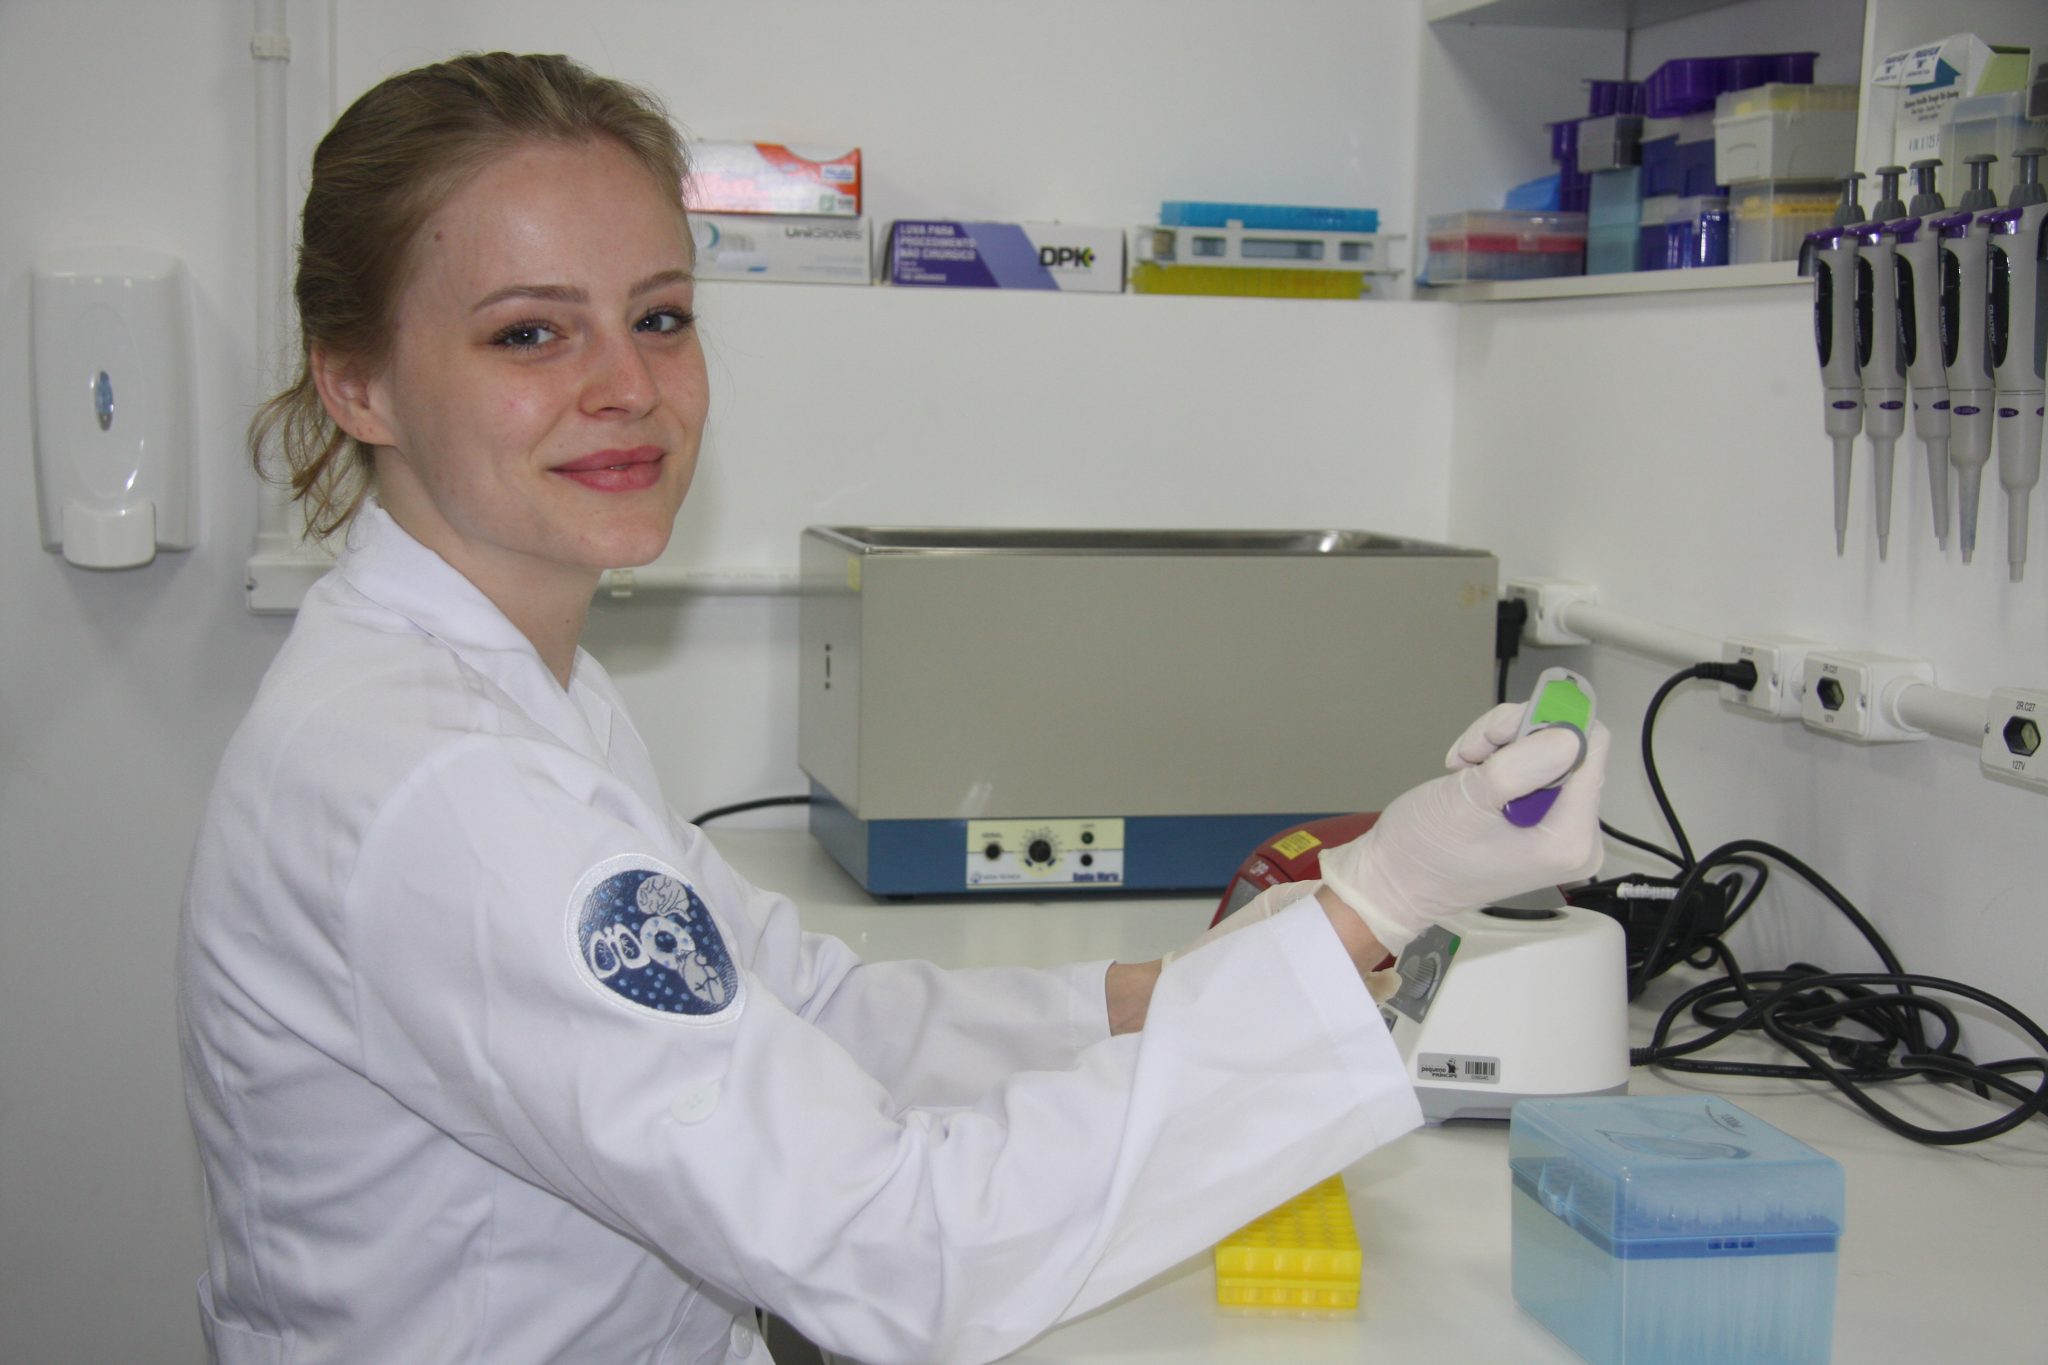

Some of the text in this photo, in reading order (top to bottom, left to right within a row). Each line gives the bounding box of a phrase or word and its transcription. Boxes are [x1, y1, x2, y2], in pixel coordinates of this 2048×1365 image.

[1039, 246, 1093, 269] DPK
[2016, 701, 2036, 713] 2R.C27
[2012, 760, 2025, 770] 127V
